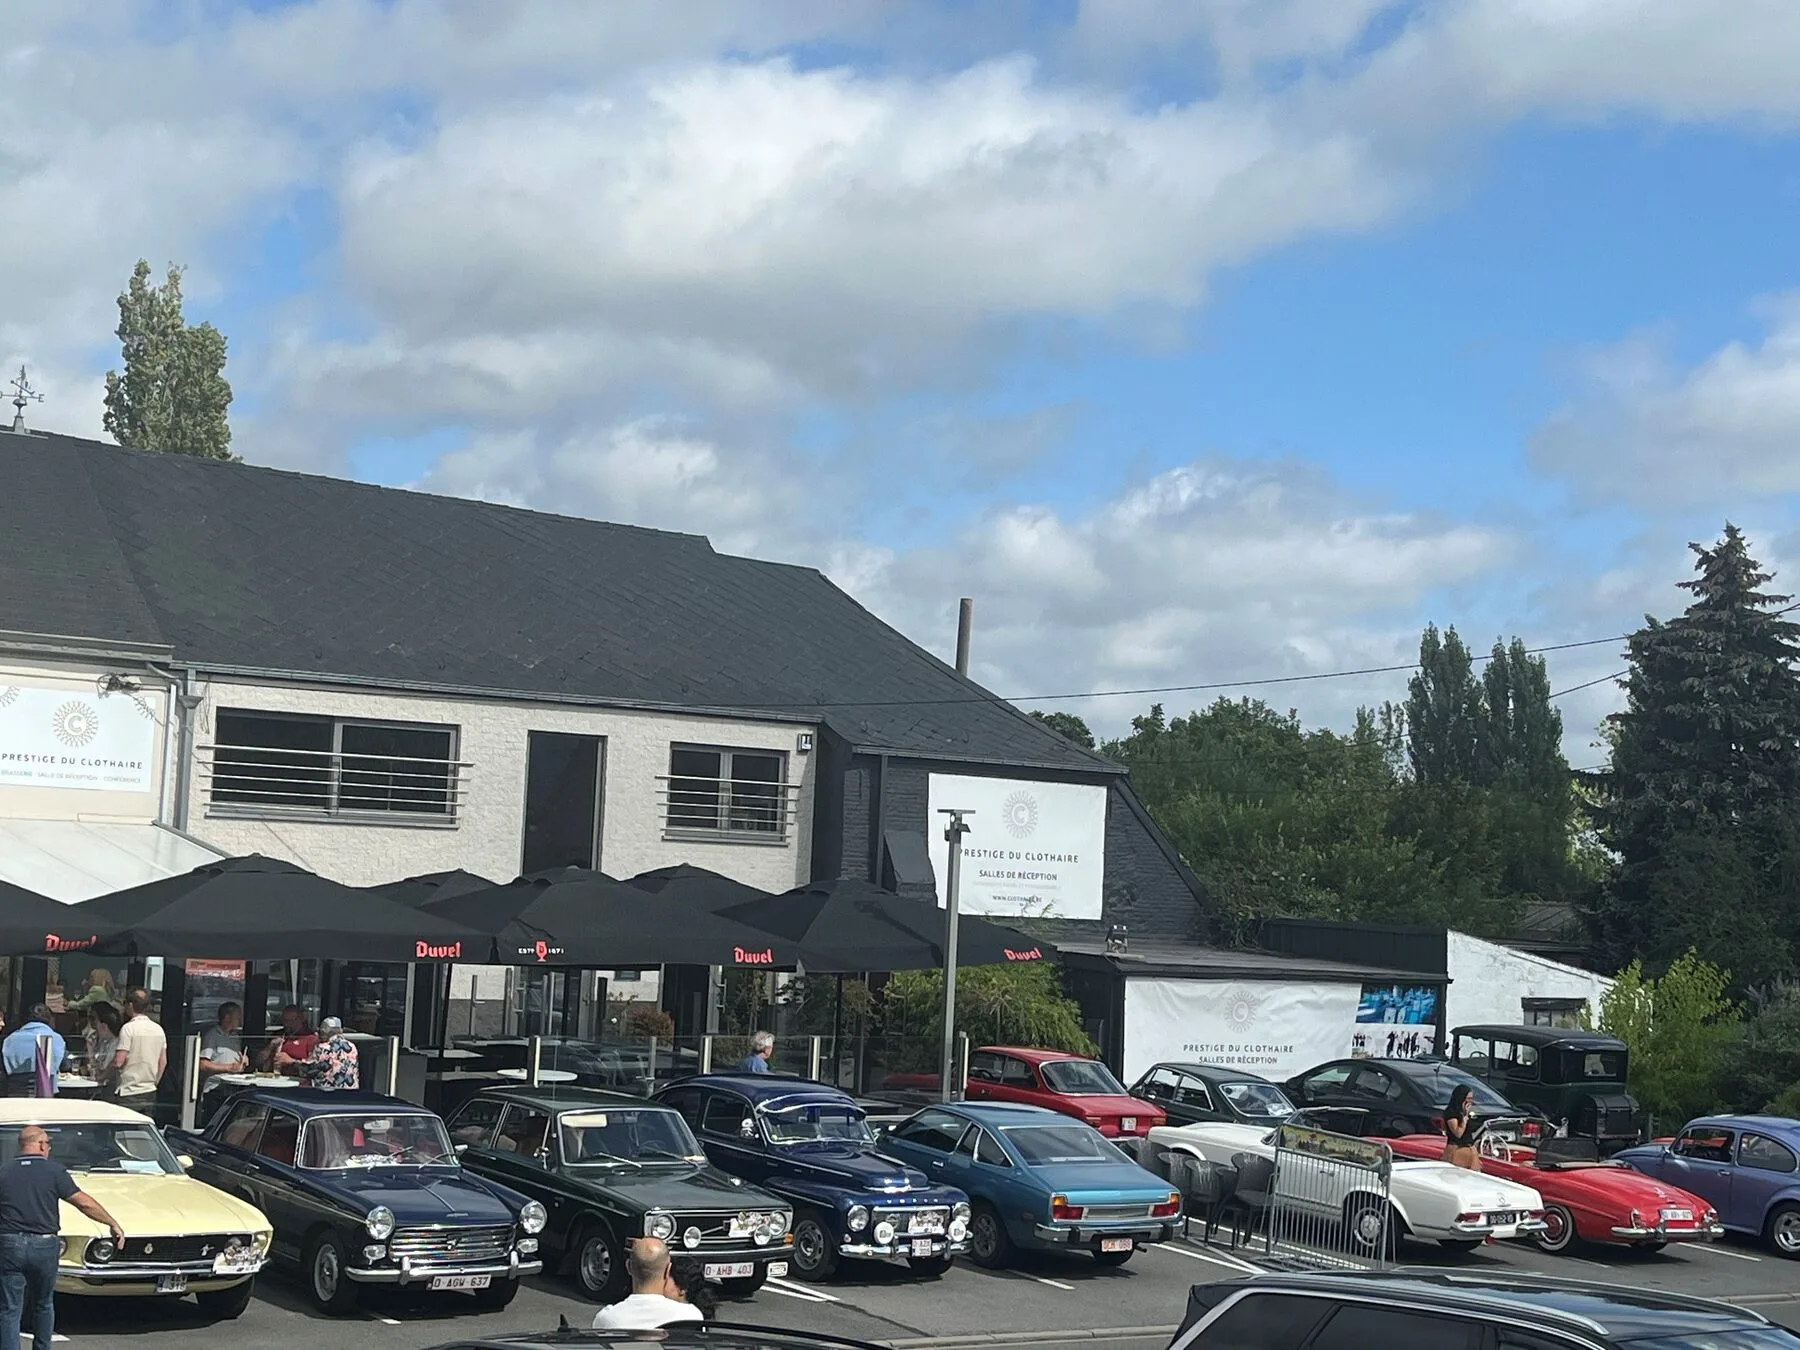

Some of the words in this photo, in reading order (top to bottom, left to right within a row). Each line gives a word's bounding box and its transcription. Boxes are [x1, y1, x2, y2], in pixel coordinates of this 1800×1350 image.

[1, 753, 56, 764] PRESTIGE
[61, 757, 76, 765] DU
[80, 758, 143, 770] CLOTHAIRE
[1008, 851, 1021, 860] DU
[1025, 852, 1079, 864] CLOTHAIRE
[979, 869, 1005, 879] SALLES
[1006, 871, 1016, 879] DE
[1017, 870, 1058, 881] RÉCEPTION
[415, 940, 461, 958] Duvel
[733, 946, 773, 964] Duvel
[1003, 947, 1042, 960] Duvel
[1183, 1044, 1225, 1053] PRESTIGE
[1228, 1044, 1241, 1053] DU
[1243, 1044, 1294, 1053] CLOTHAIRE
[1199, 1055, 1225, 1064] SALLES
[1225, 1056, 1236, 1064] DE
[1236, 1054, 1278, 1065] RÉCEPTION
